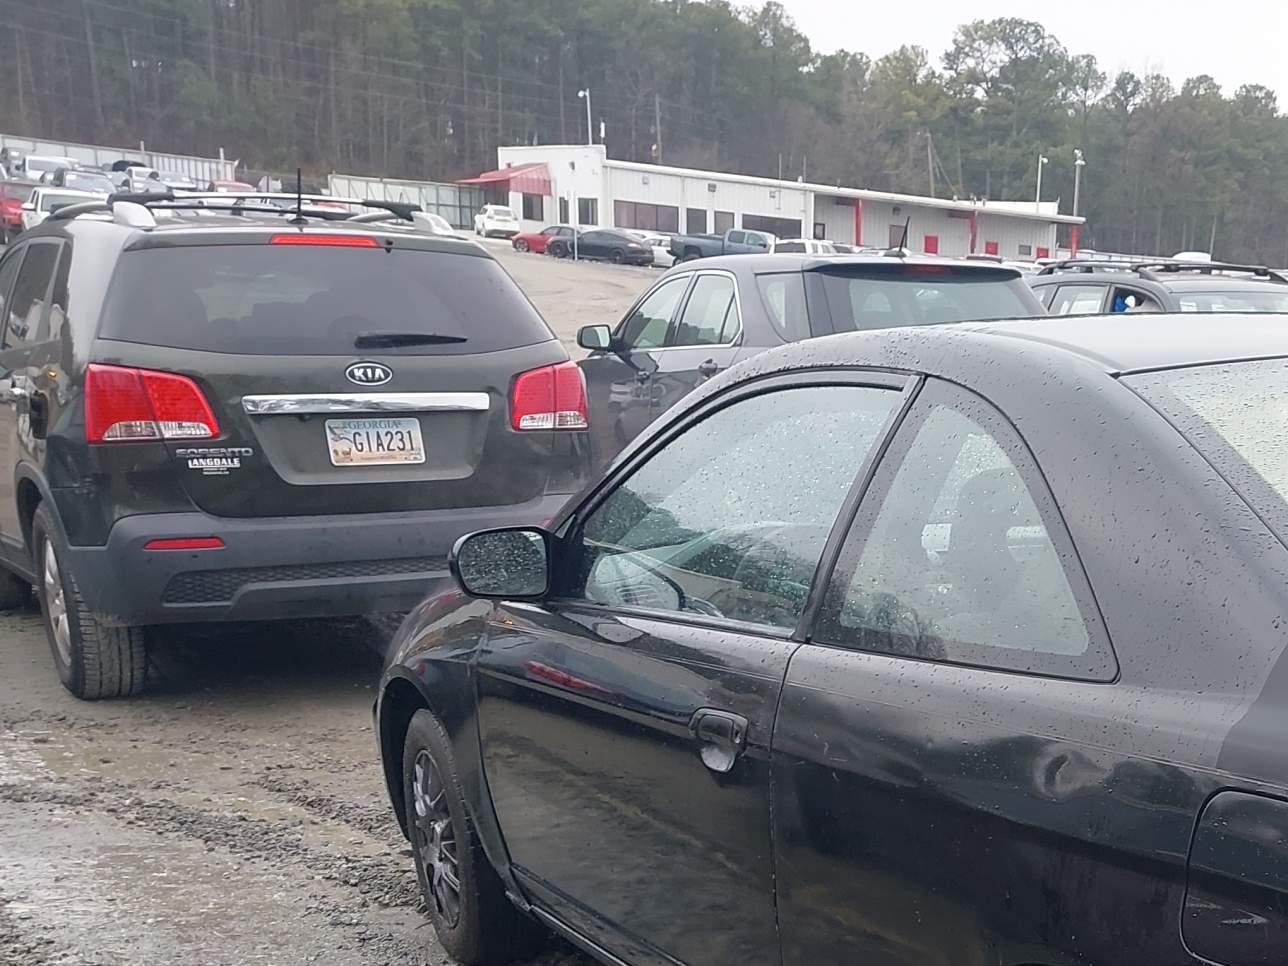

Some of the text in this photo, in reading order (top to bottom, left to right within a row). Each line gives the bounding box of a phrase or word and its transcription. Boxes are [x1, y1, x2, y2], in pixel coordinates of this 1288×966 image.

[353, 368, 385, 381] KIA
[349, 420, 399, 429] GEORGIA
[353, 430, 415, 453] GIA231
[188, 457, 241, 468] LANGDALE
